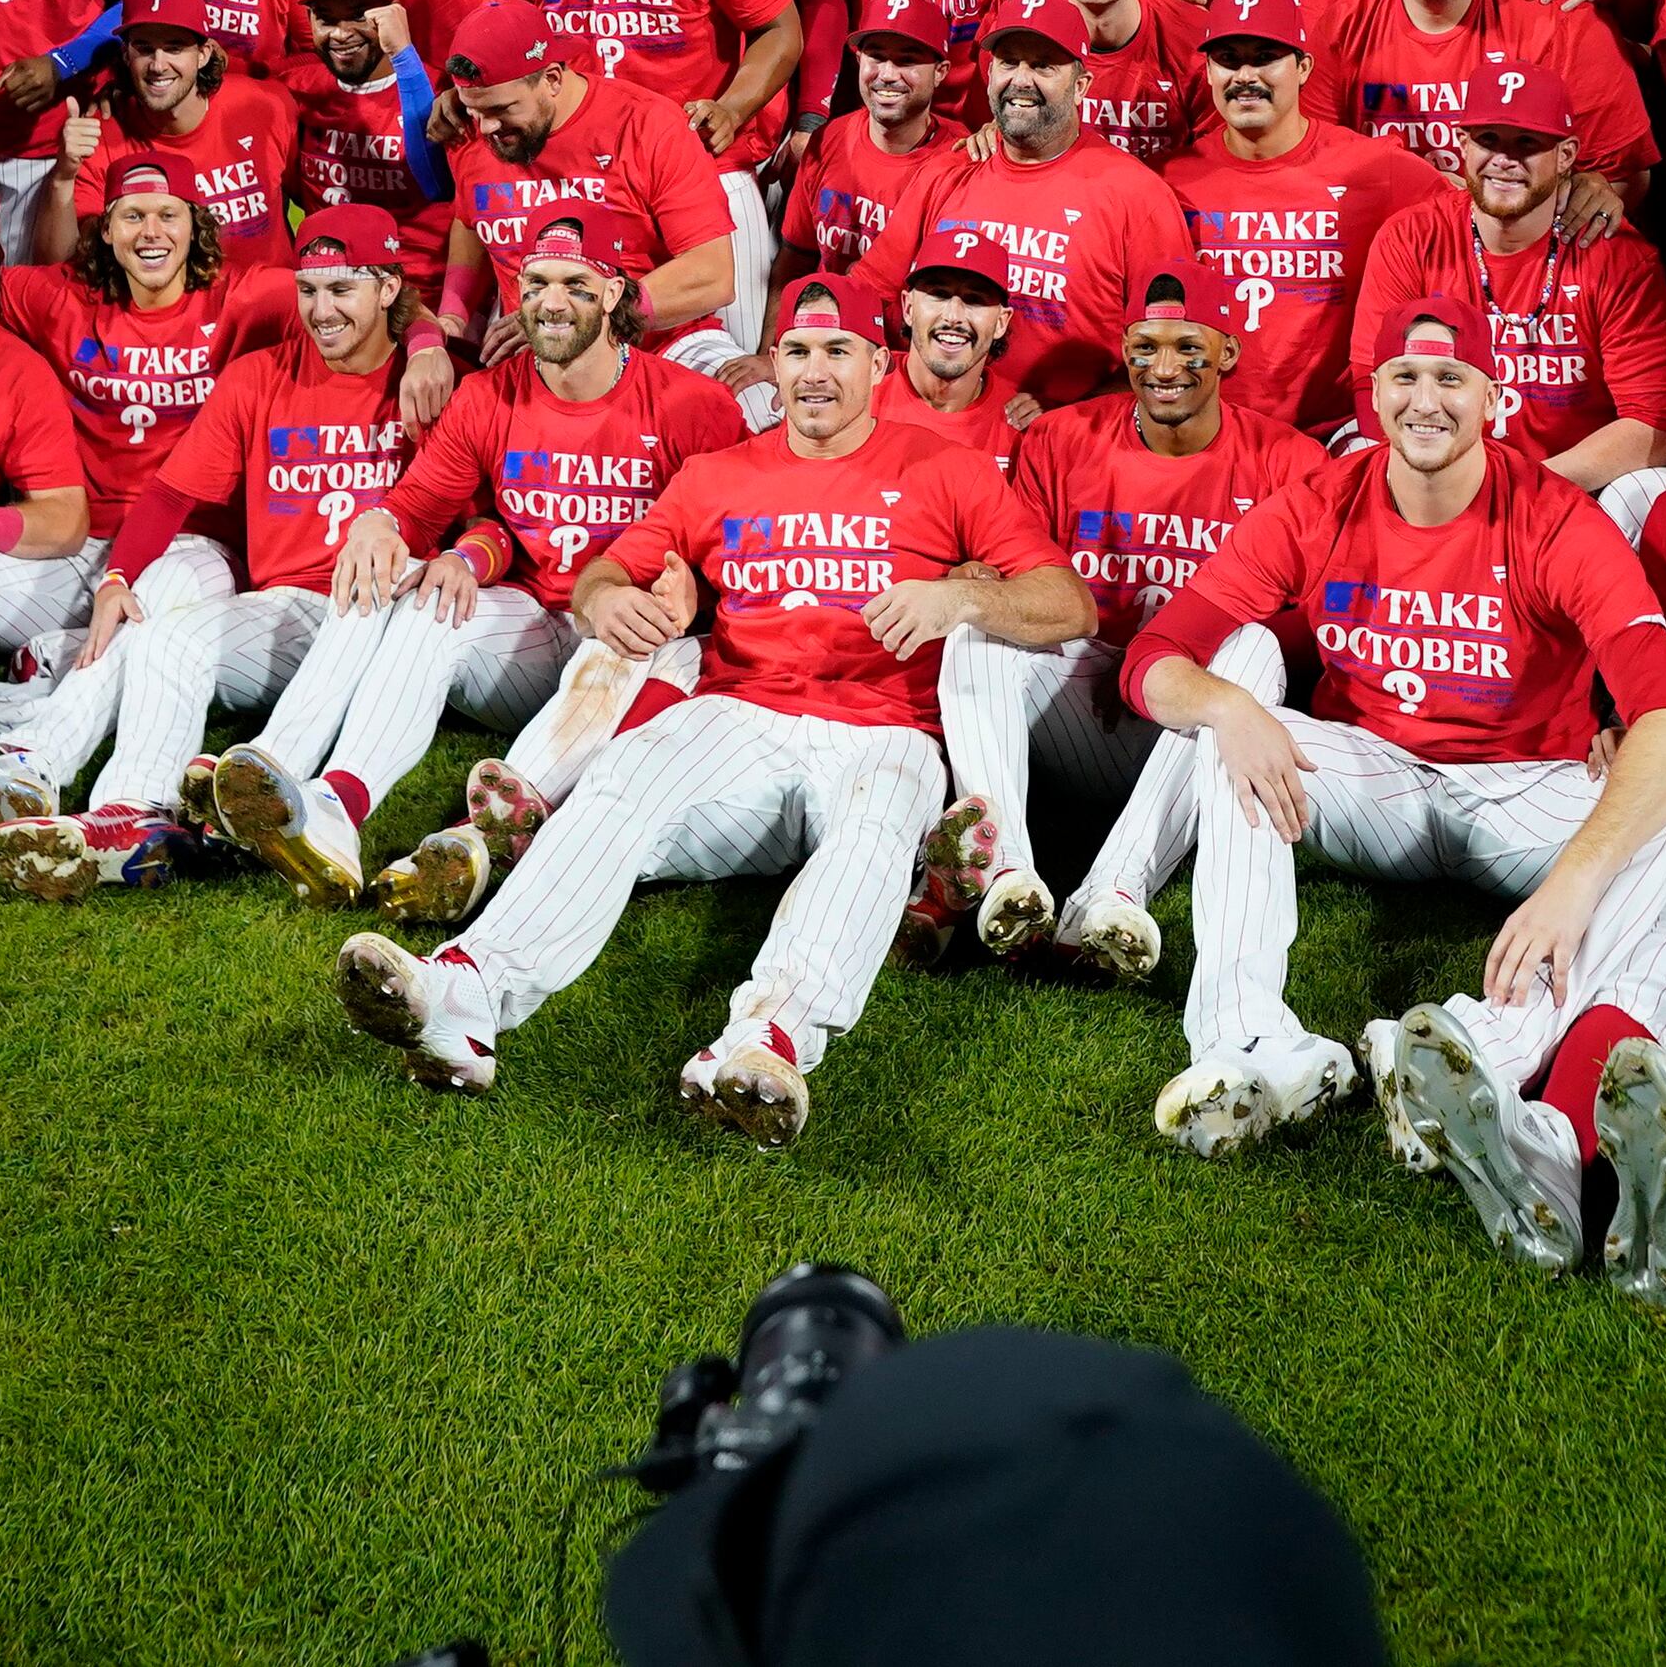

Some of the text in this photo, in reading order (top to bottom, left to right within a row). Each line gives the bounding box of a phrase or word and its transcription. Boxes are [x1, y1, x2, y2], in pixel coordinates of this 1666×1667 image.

[546, 10, 683, 35] OCTOBER
[1081, 98, 1168, 128] TAKE
[327, 130, 401, 160] TAKE
[305, 155, 407, 192] CTOBER
[516, 178, 605, 207] TAKE
[1230, 211, 1339, 241] TAKE
[1198, 249, 1342, 278] CTOBER
[1235, 278, 1274, 331] P
[1490, 313, 1578, 345] TAKE
[124, 346, 209, 375] TAKE
[70, 371, 215, 406] OCTOBER
[121, 405, 156, 443] P
[319, 421, 403, 455] TAKE
[553, 453, 652, 487] TAKE
[318, 491, 355, 545] P
[778, 513, 890, 549] TAKE
[550, 525, 592, 573] P
[721, 557, 893, 595] OCTOBER
[1381, 589, 1502, 632] TAKE
[1317, 624, 1511, 678] OCTOBER
[1383, 670, 1426, 715] P
